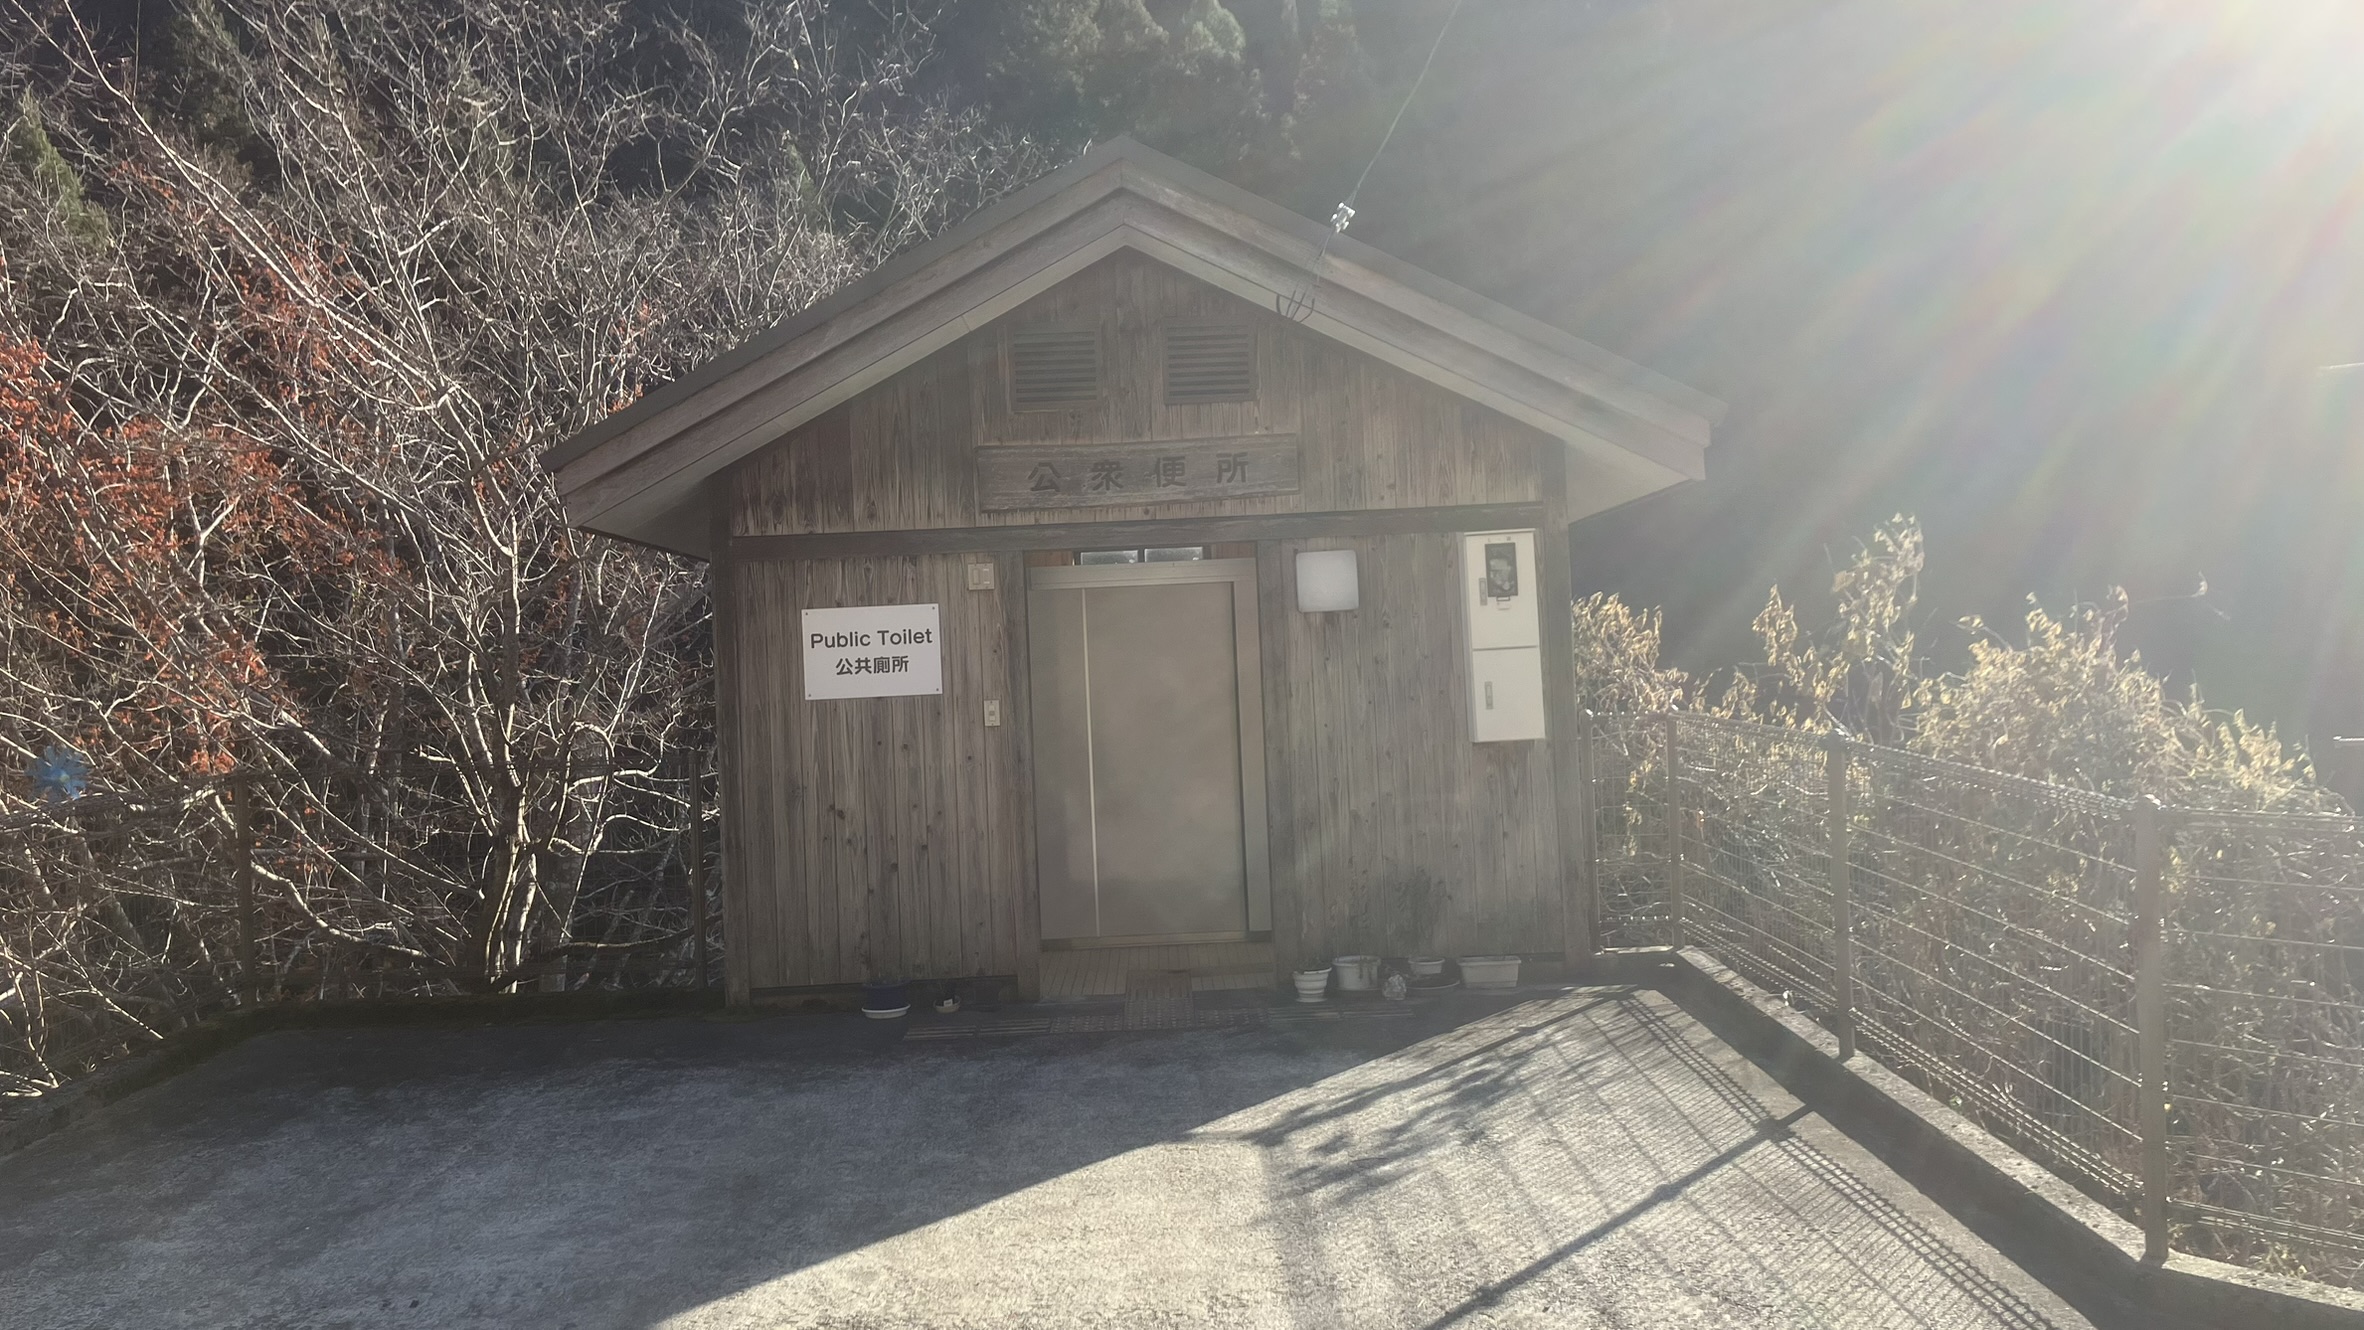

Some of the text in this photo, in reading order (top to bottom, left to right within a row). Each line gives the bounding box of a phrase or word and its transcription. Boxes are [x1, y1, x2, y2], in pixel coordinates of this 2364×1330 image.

[1028, 452, 1249, 493] 公衆便所
[810, 628, 933, 649] Public Toilet
[835, 655, 909, 676] 公共廁所
